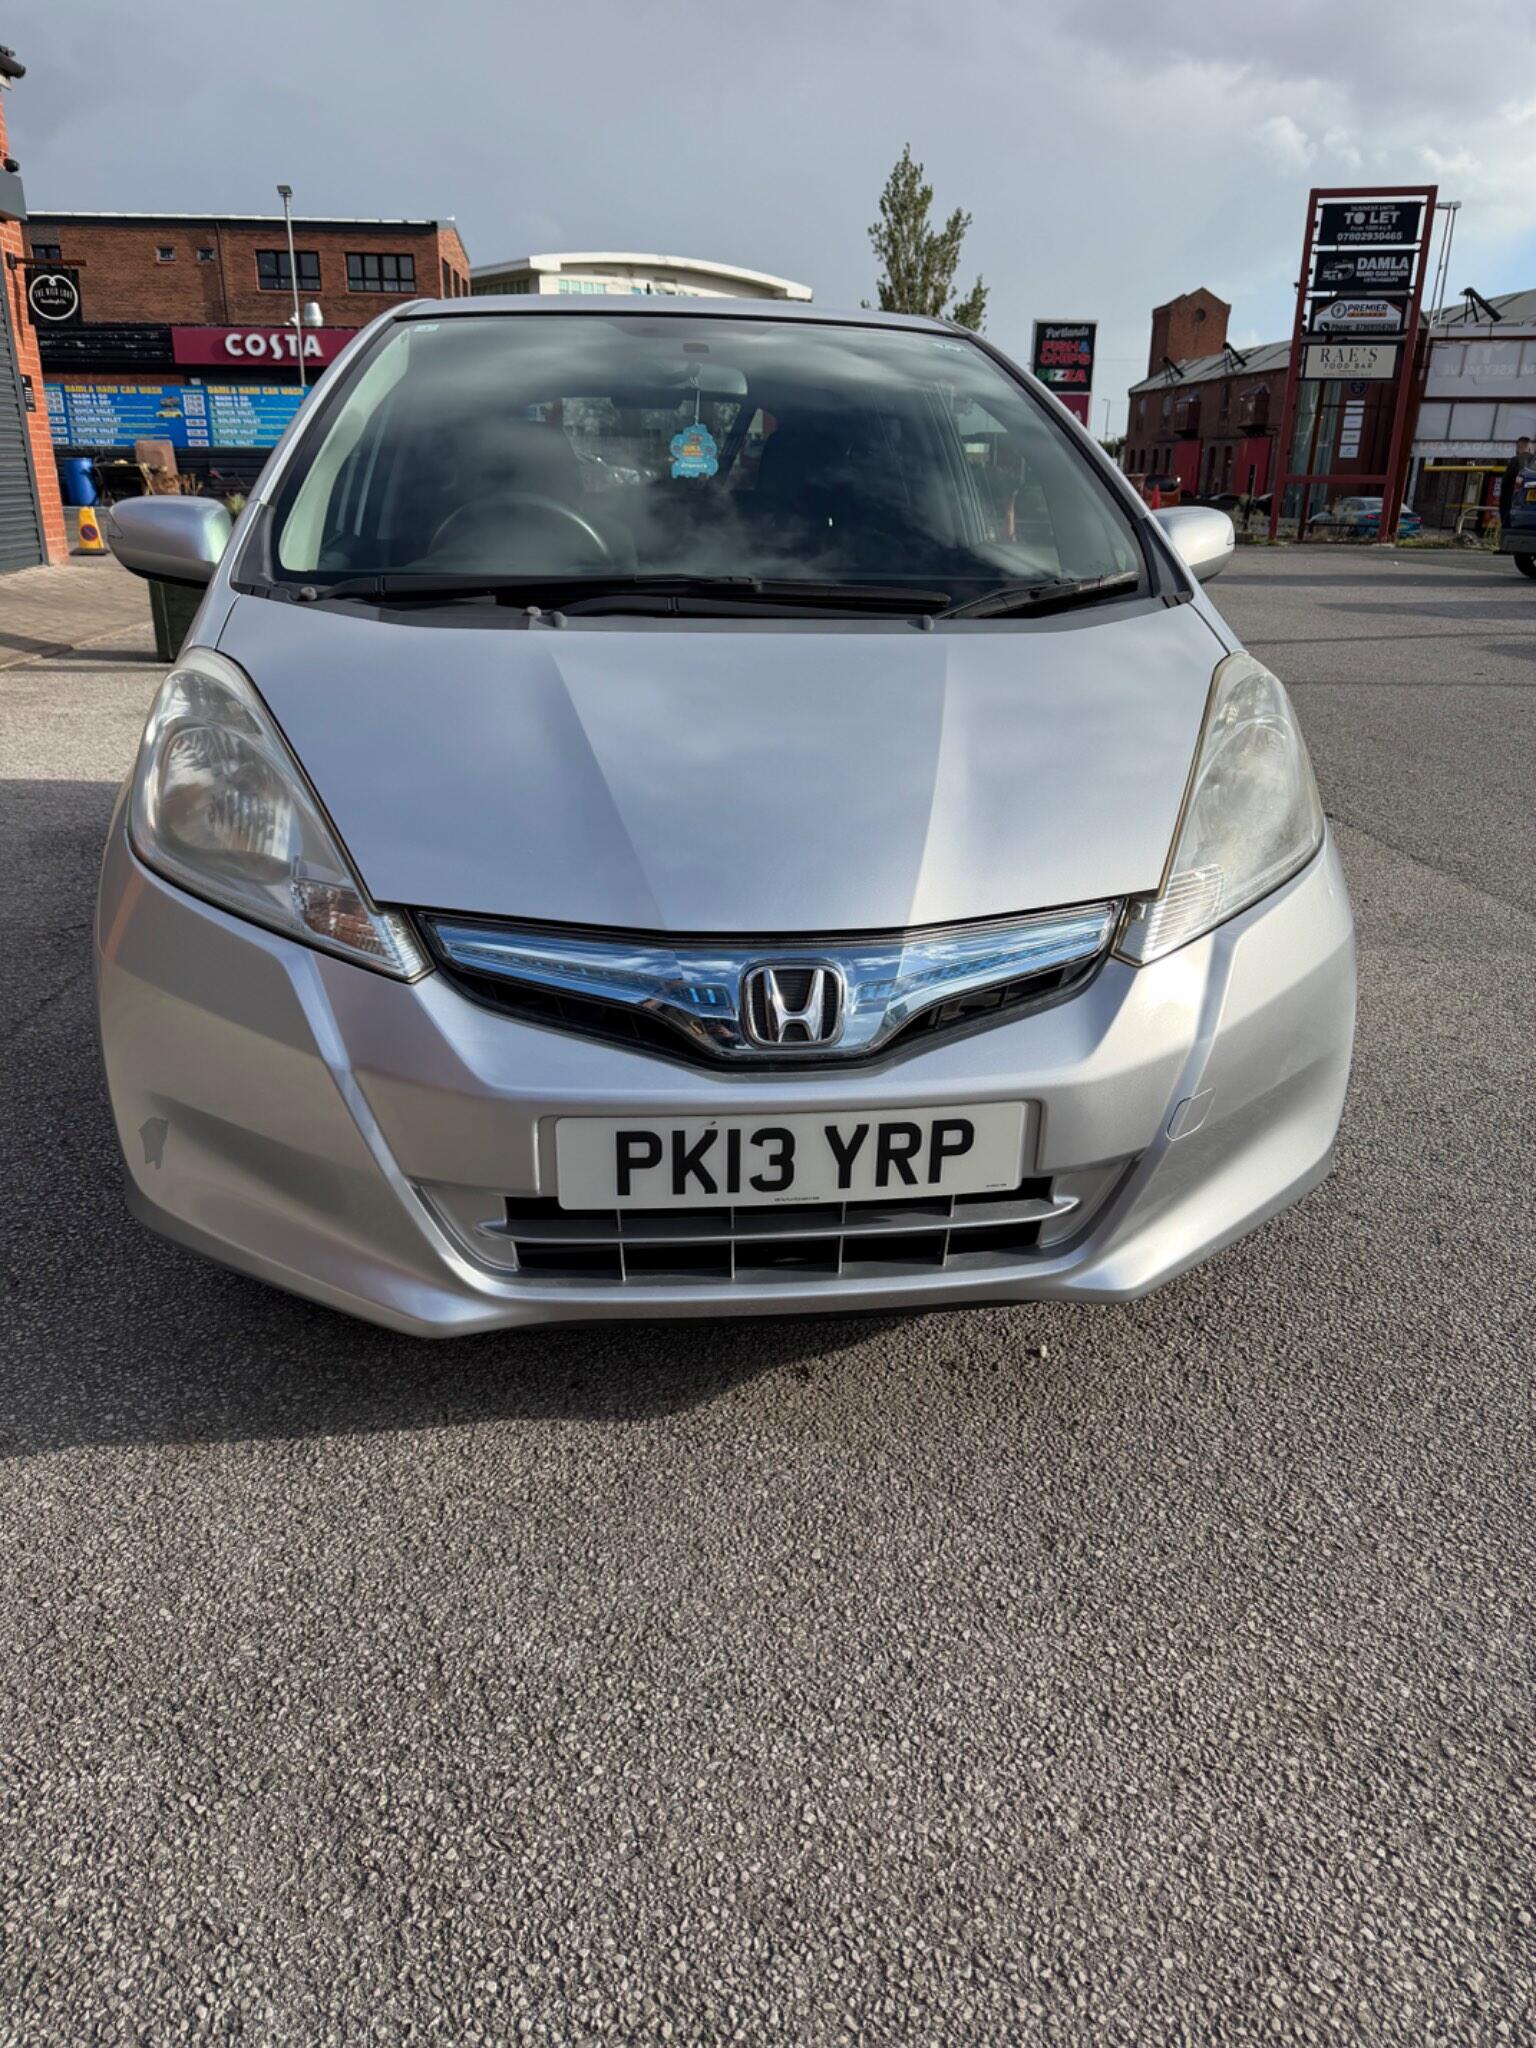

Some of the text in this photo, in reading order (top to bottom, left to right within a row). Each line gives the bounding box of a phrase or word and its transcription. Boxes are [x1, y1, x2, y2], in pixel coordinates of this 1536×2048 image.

[1344, 211, 1400, 224] TO LET
[1357, 256, 1409, 270] DAMLA
[1347, 303, 1388, 312] PREMIER
[225, 333, 324, 360] COSTA
[1042, 341, 1079, 353] FISH
[1040, 353, 1090, 365] CHIPS
[1320, 347, 1378, 362] RAE'S
[1037, 369, 1087, 382] PIZZA
[120, 386, 137, 394] CAR
[262, 387, 279, 395] CAR
[615, 1118, 975, 1196] PK13 YRP
